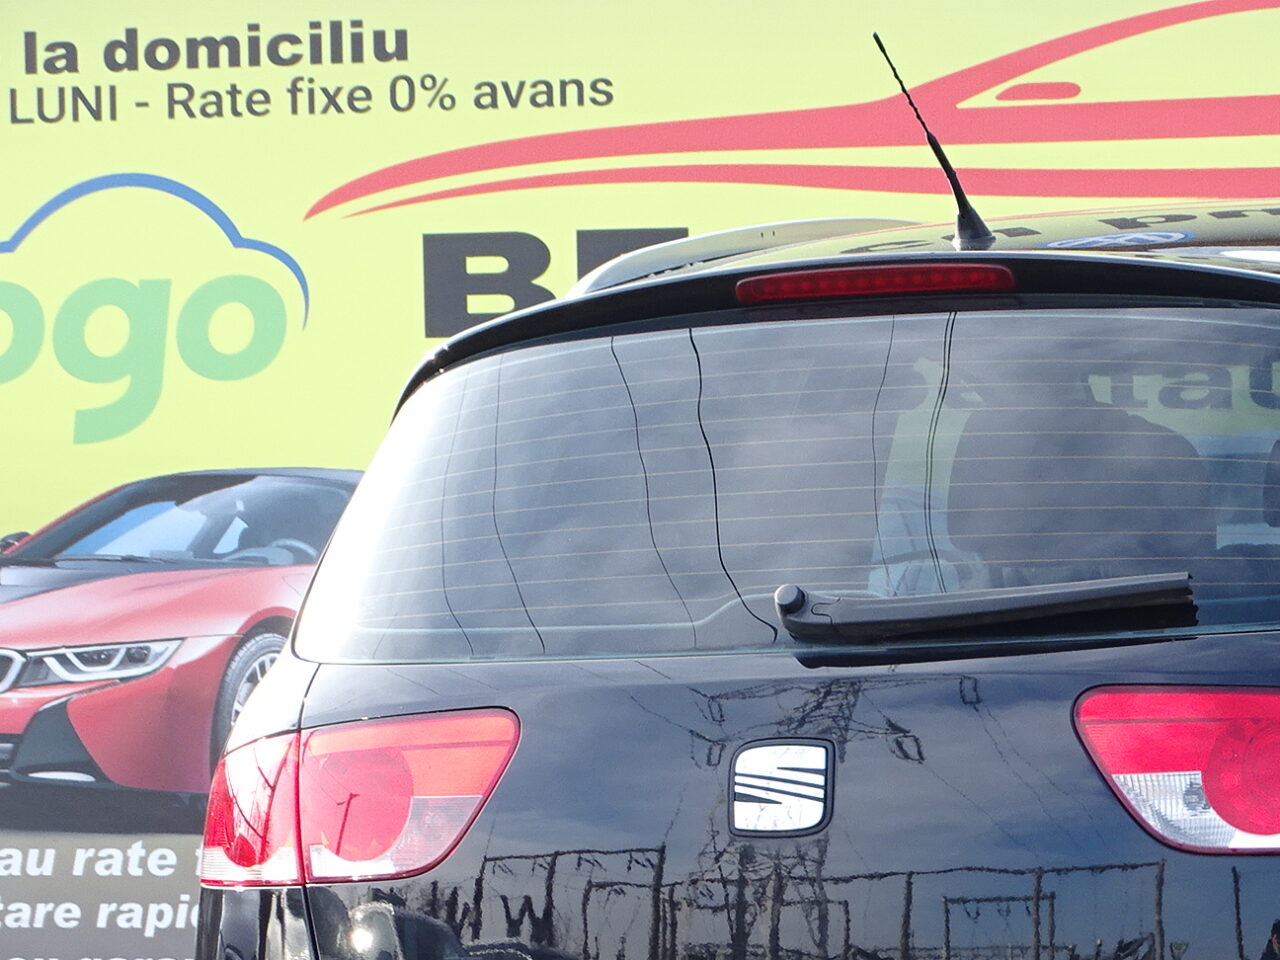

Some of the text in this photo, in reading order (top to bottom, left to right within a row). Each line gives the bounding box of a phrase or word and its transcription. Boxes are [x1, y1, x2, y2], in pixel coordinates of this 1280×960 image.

[23, 20, 410, 75] la domiciliu
[8, 84, 118, 124] LUNI
[166, 79, 272, 119] Rate
[286, 76, 373, 116] fixe
[389, 73, 457, 113] 0%
[473, 76, 615, 110] avans
[0, 848, 56, 877] au
[72, 840, 178, 877] rate
[0, 894, 82, 929] are
